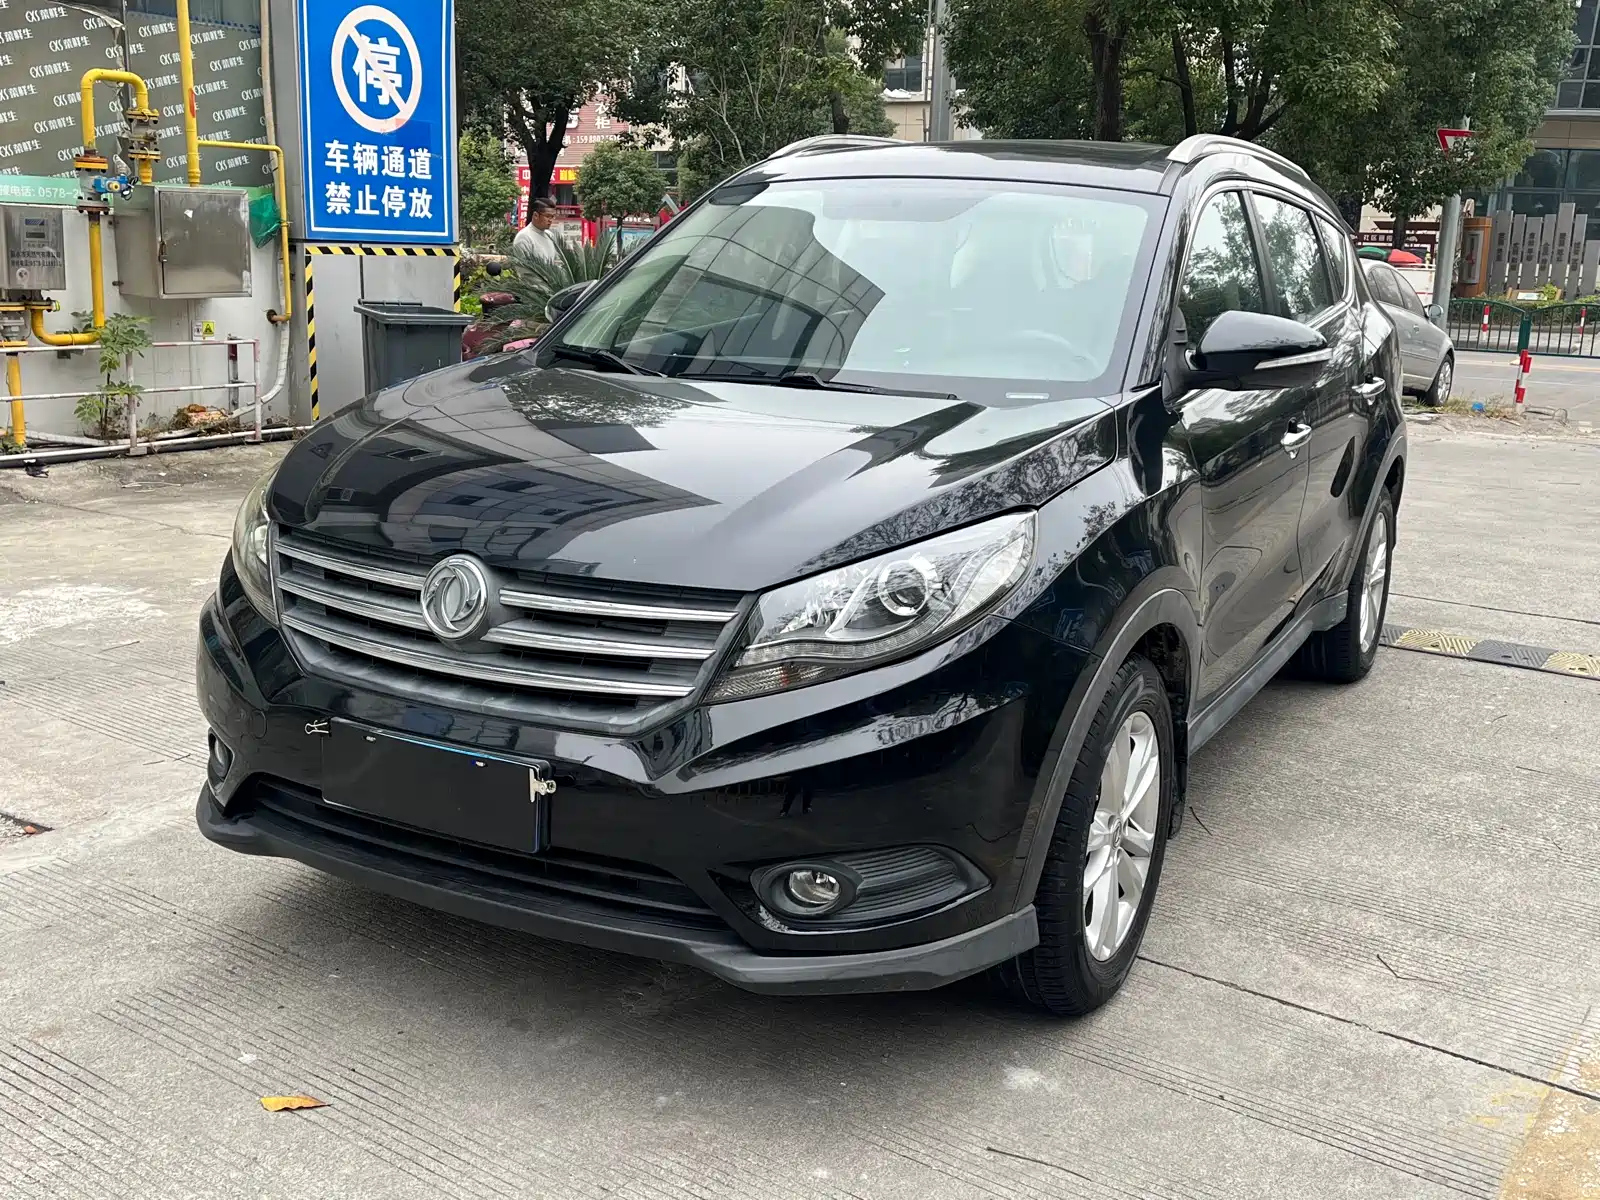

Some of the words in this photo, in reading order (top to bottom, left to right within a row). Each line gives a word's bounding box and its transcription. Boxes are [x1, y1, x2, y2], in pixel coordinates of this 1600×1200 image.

[325, 140, 432, 180] 车辆通道
[325, 181, 433, 219] 禁止停放
